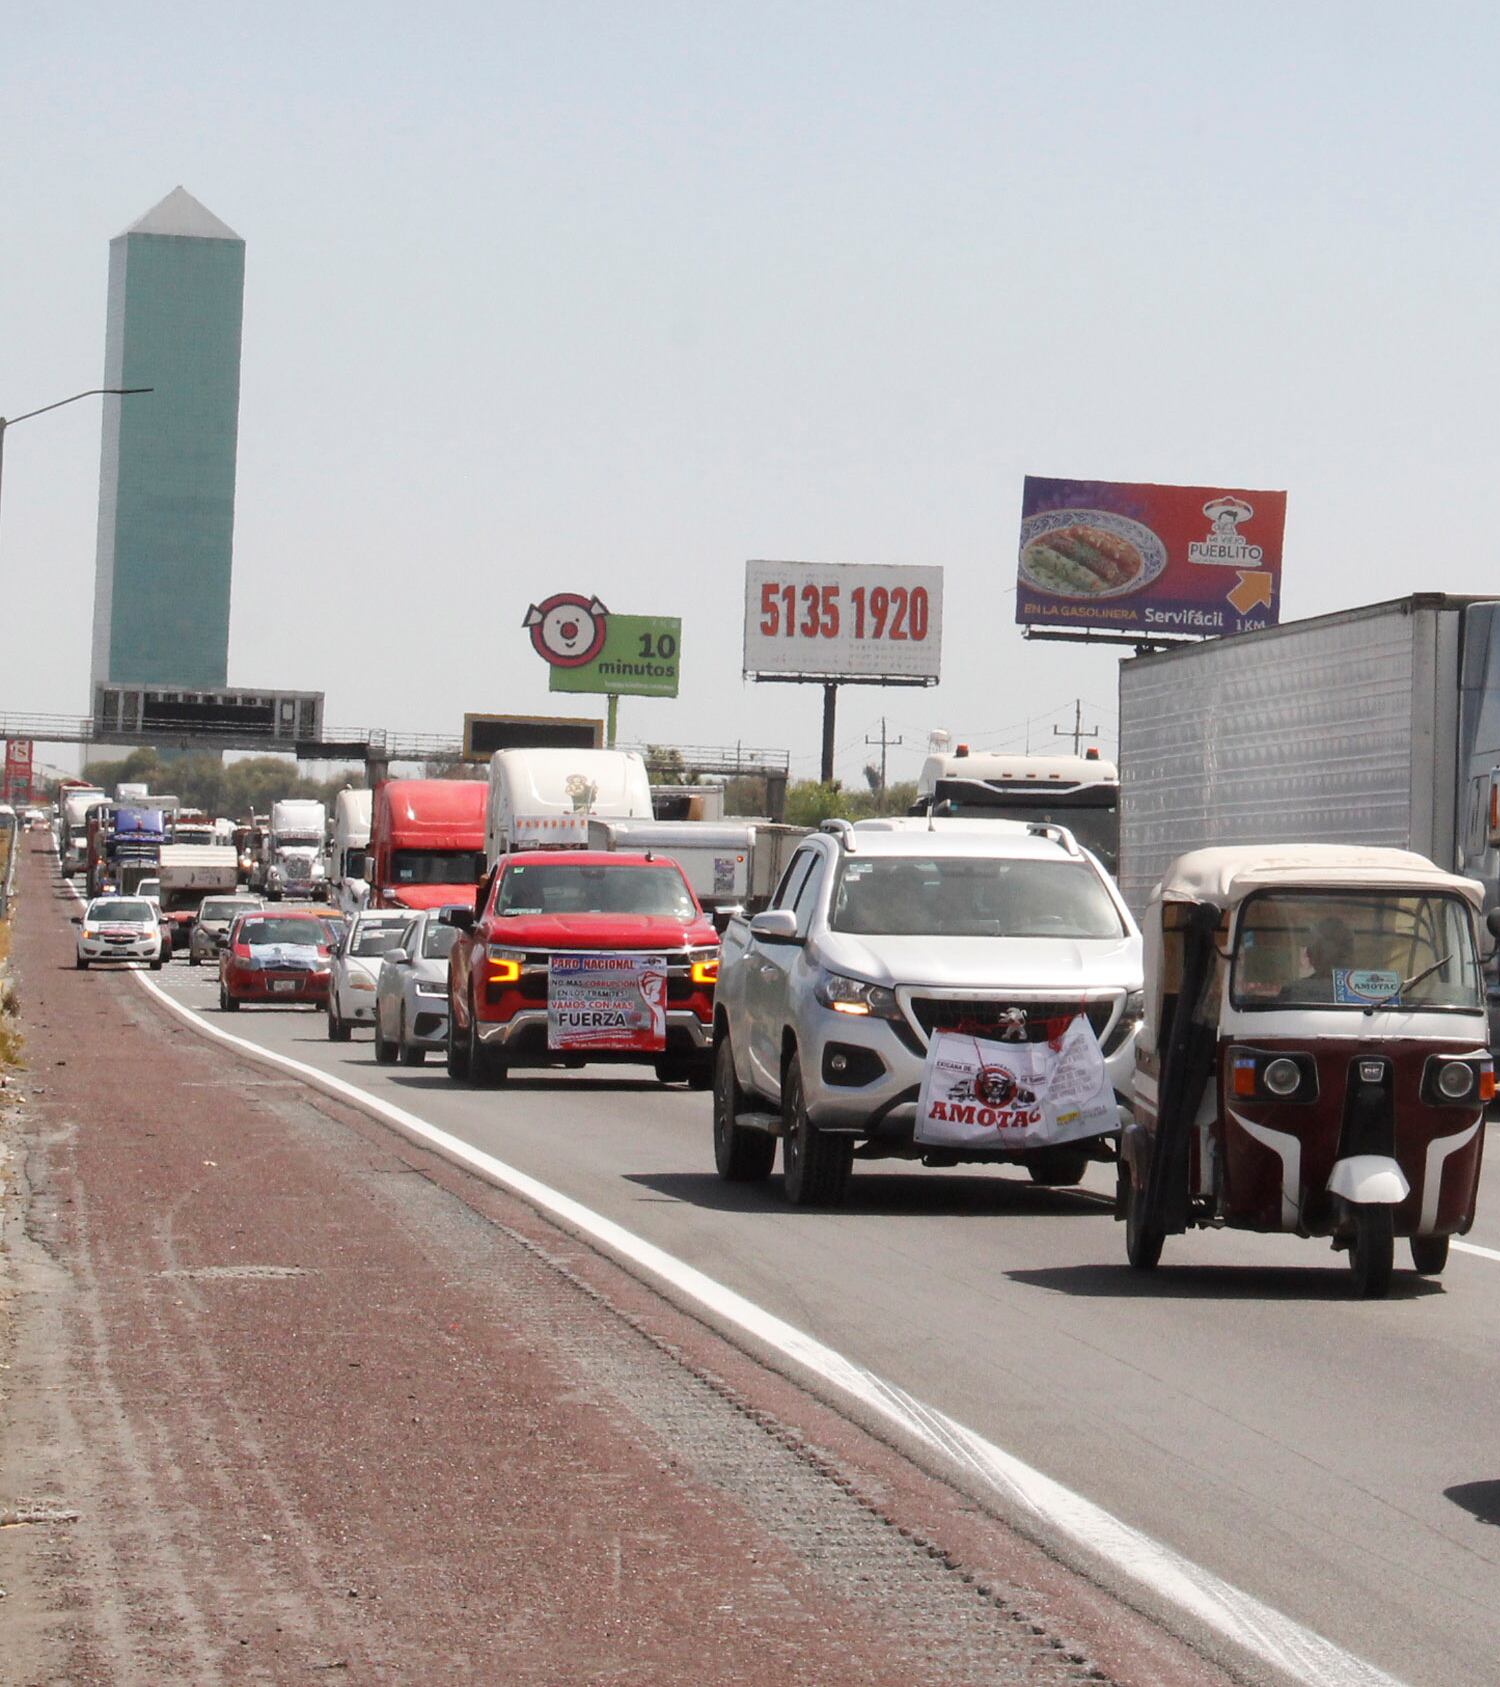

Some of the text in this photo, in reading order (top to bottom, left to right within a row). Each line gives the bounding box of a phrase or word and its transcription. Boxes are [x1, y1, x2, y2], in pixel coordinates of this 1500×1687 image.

[1190, 543, 1262, 560] PUEBLITO
[760, 583, 929, 641] 5135 1920
[1024, 603, 1138, 621] EN LA GASOLINERA
[1144, 607, 1224, 627] Servifácil
[639, 633, 676, 659] 10
[598, 659, 675, 678] minutos
[551, 958, 580, 970] PARO
[583, 959, 636, 970] NACIONAL
[1354, 982, 1398, 990] AMOTAC
[551, 1000, 635, 1010] VAMOS CON MAS
[558, 1011, 626, 1027] FUERZA
